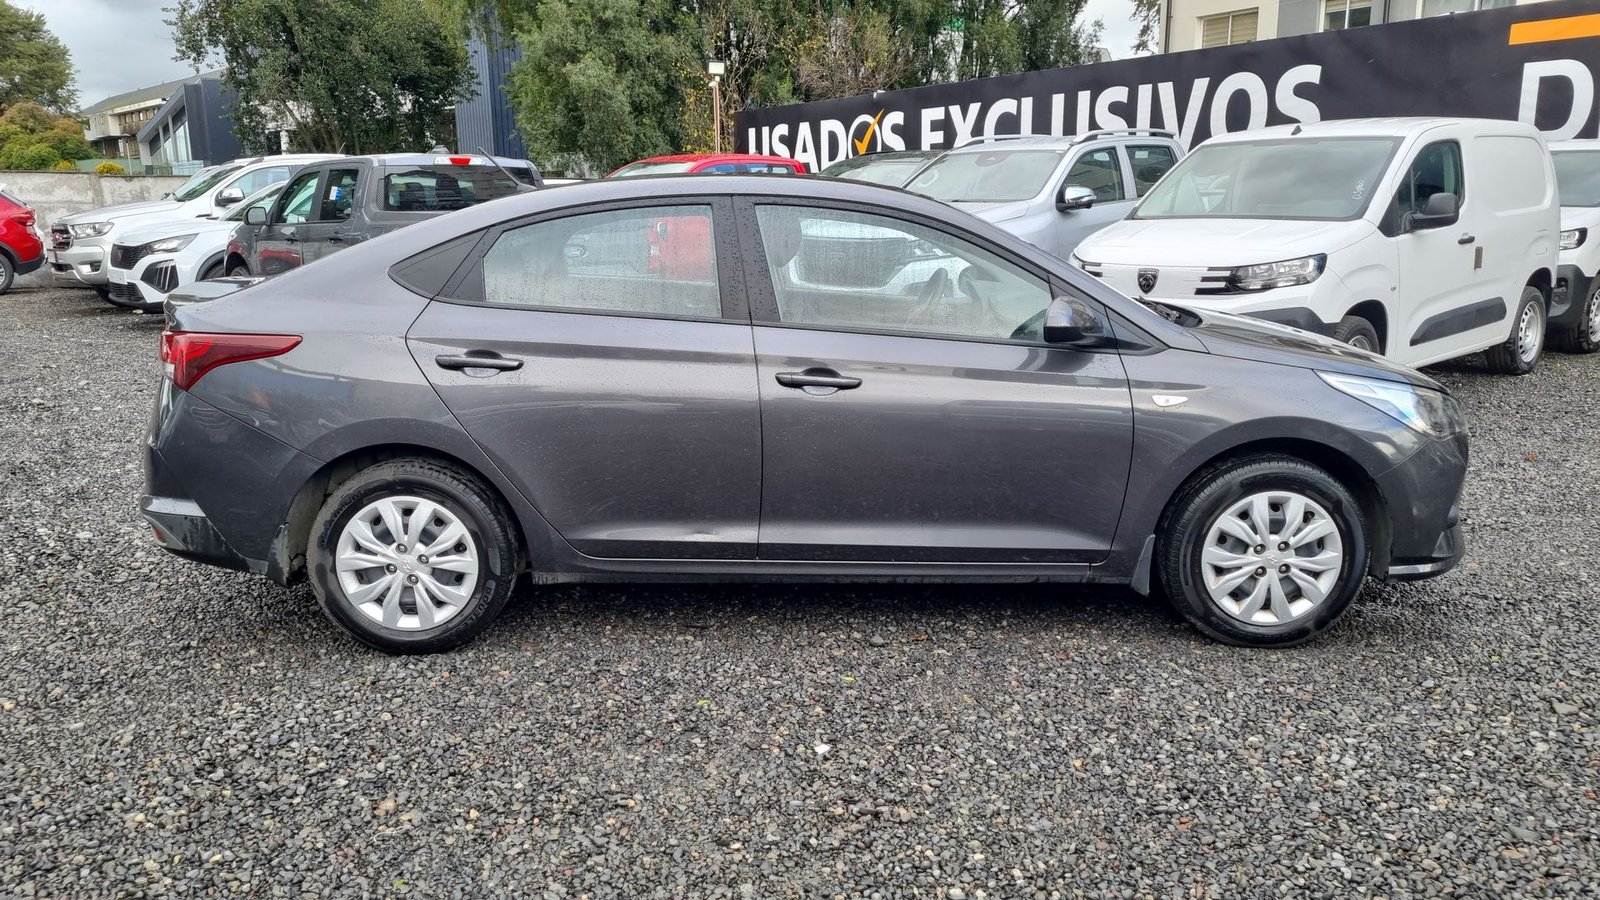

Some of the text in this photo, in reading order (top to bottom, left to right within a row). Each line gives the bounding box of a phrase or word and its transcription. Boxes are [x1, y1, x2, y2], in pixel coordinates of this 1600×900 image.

[748, 64, 1322, 174] USADOS EXCLUSIVOS
[1517, 58, 1600, 140] D
